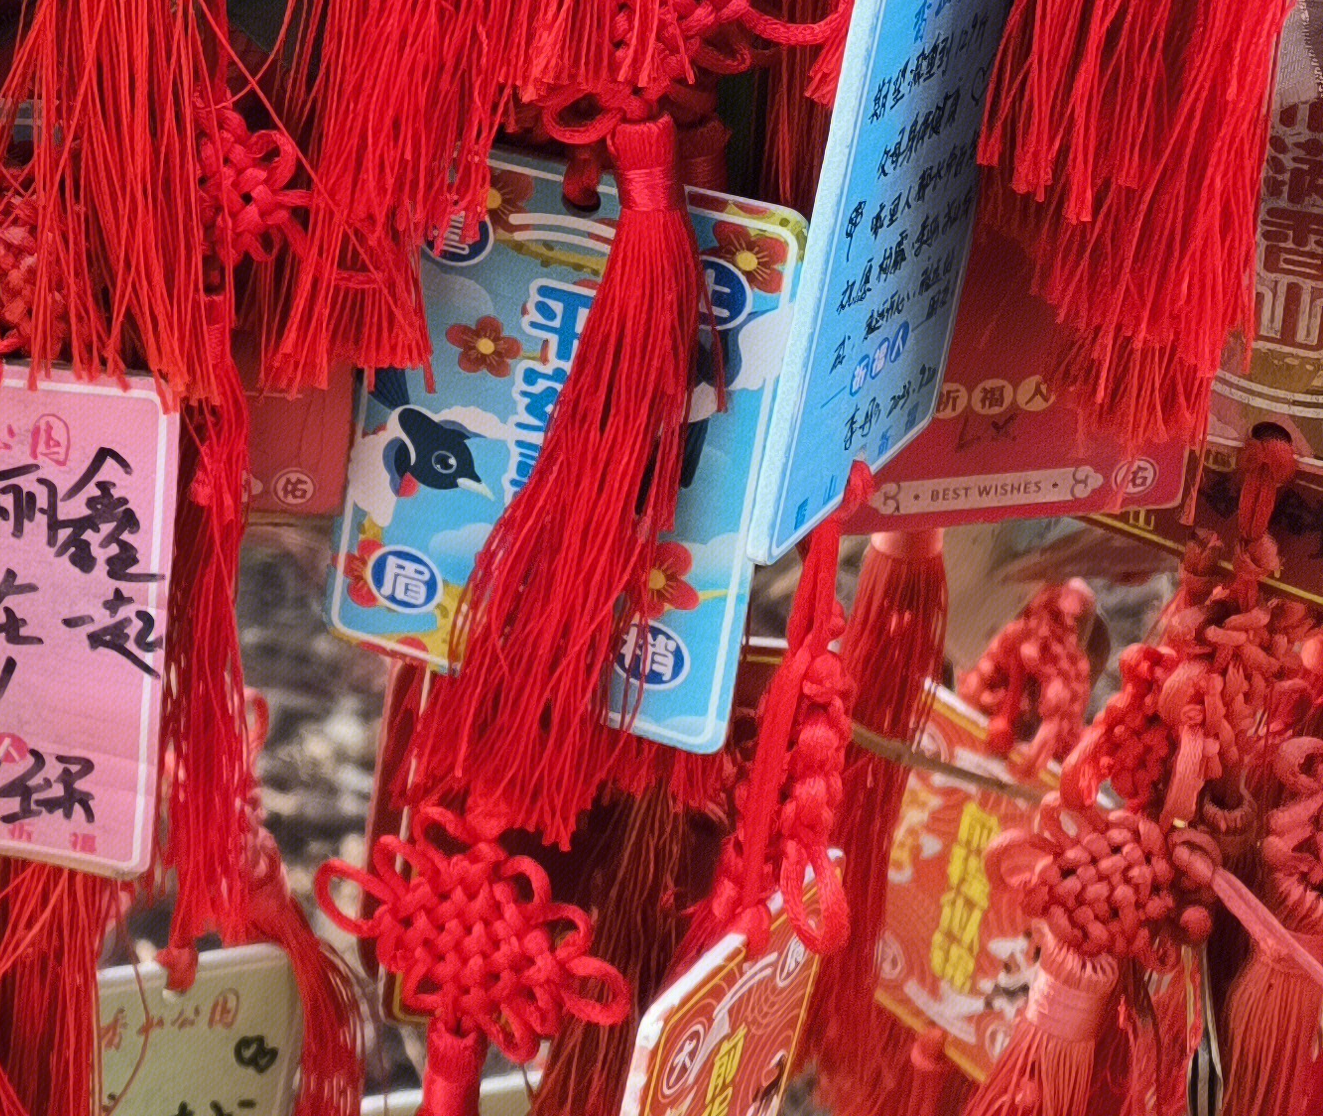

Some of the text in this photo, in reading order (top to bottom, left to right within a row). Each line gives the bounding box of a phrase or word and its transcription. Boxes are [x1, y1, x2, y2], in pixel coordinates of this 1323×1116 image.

[851, 322, 909, 397] 祈福人
[935, 383, 1050, 414] 祈福人
[929, 481, 1043, 503] BEST WISHES
[383, 557, 439, 605] 眉
